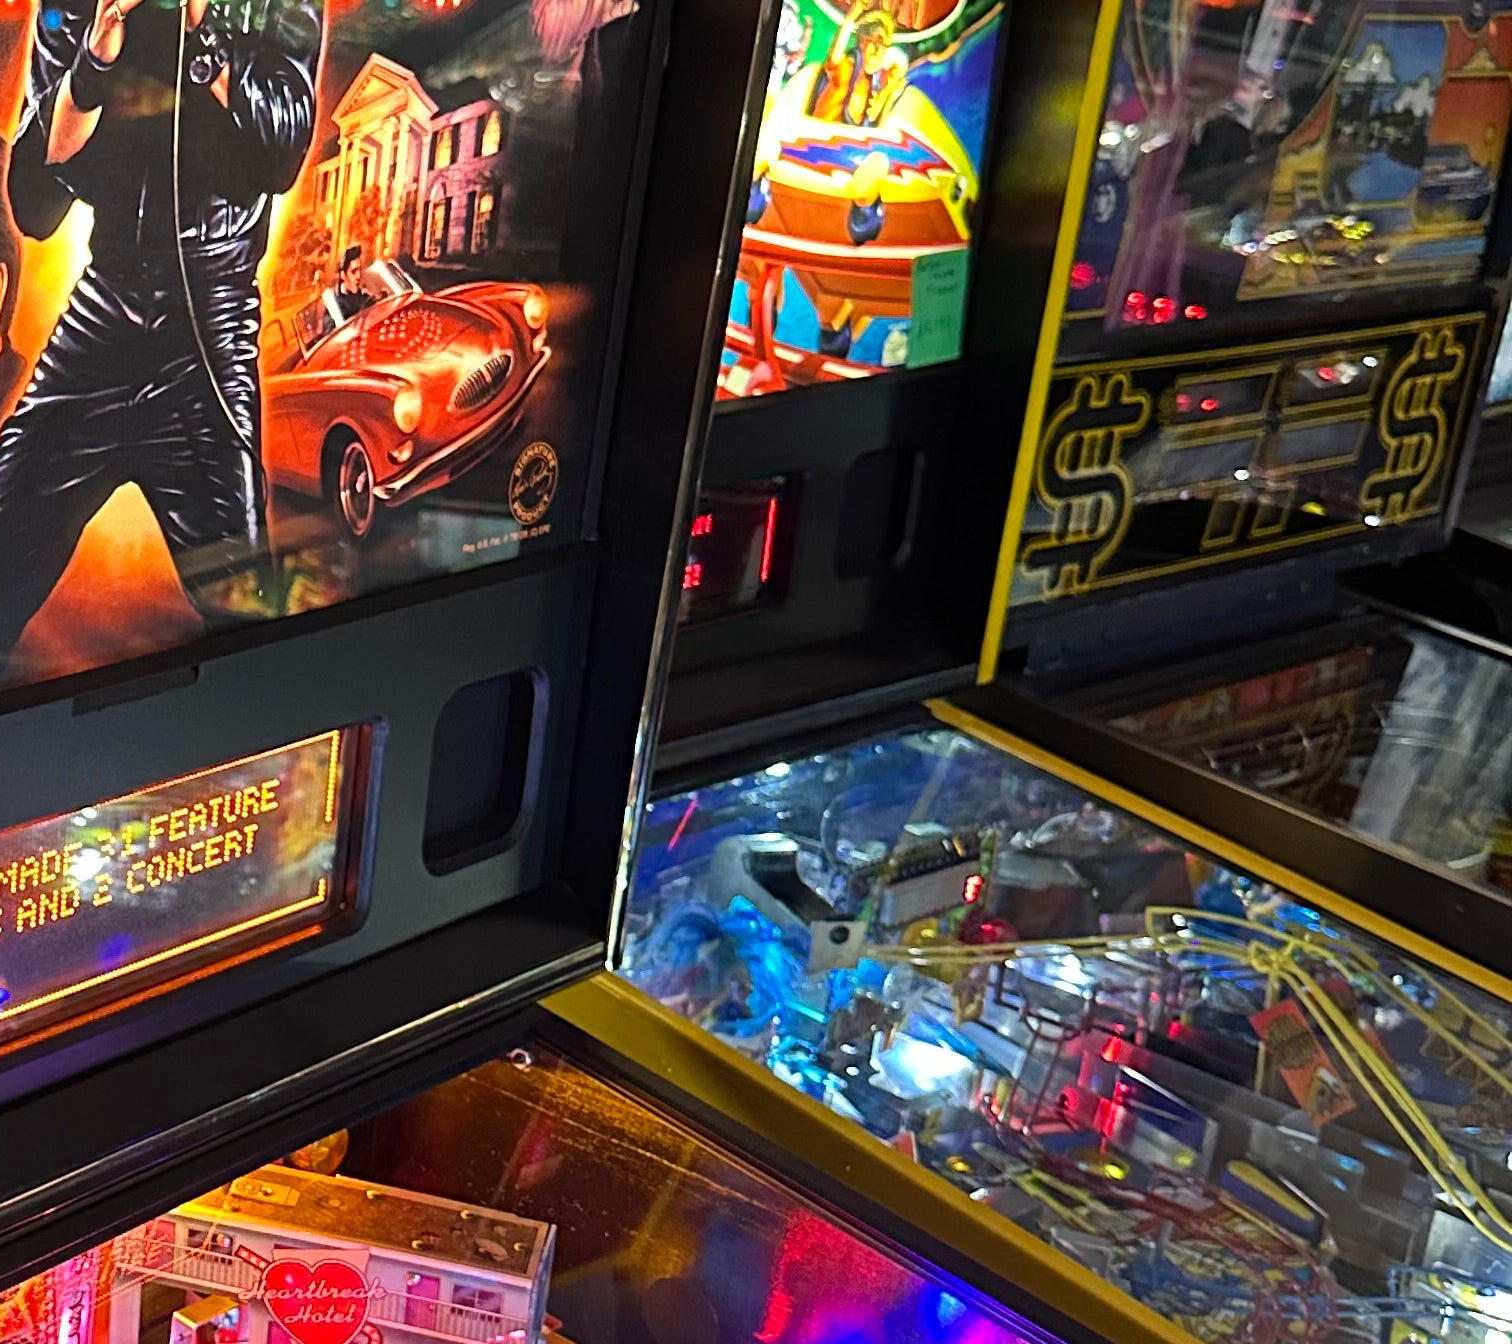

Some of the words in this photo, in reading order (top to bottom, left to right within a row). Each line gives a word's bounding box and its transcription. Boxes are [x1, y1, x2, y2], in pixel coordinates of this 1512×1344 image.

[148, 778, 282, 848] FEATURE
[15, 884, 81, 934] AND
[91, 872, 115, 907] 2
[124, 822, 261, 896] CONCERT
[238, 1277, 388, 1302] Heartbreak
[284, 1304, 356, 1325] Hotel
